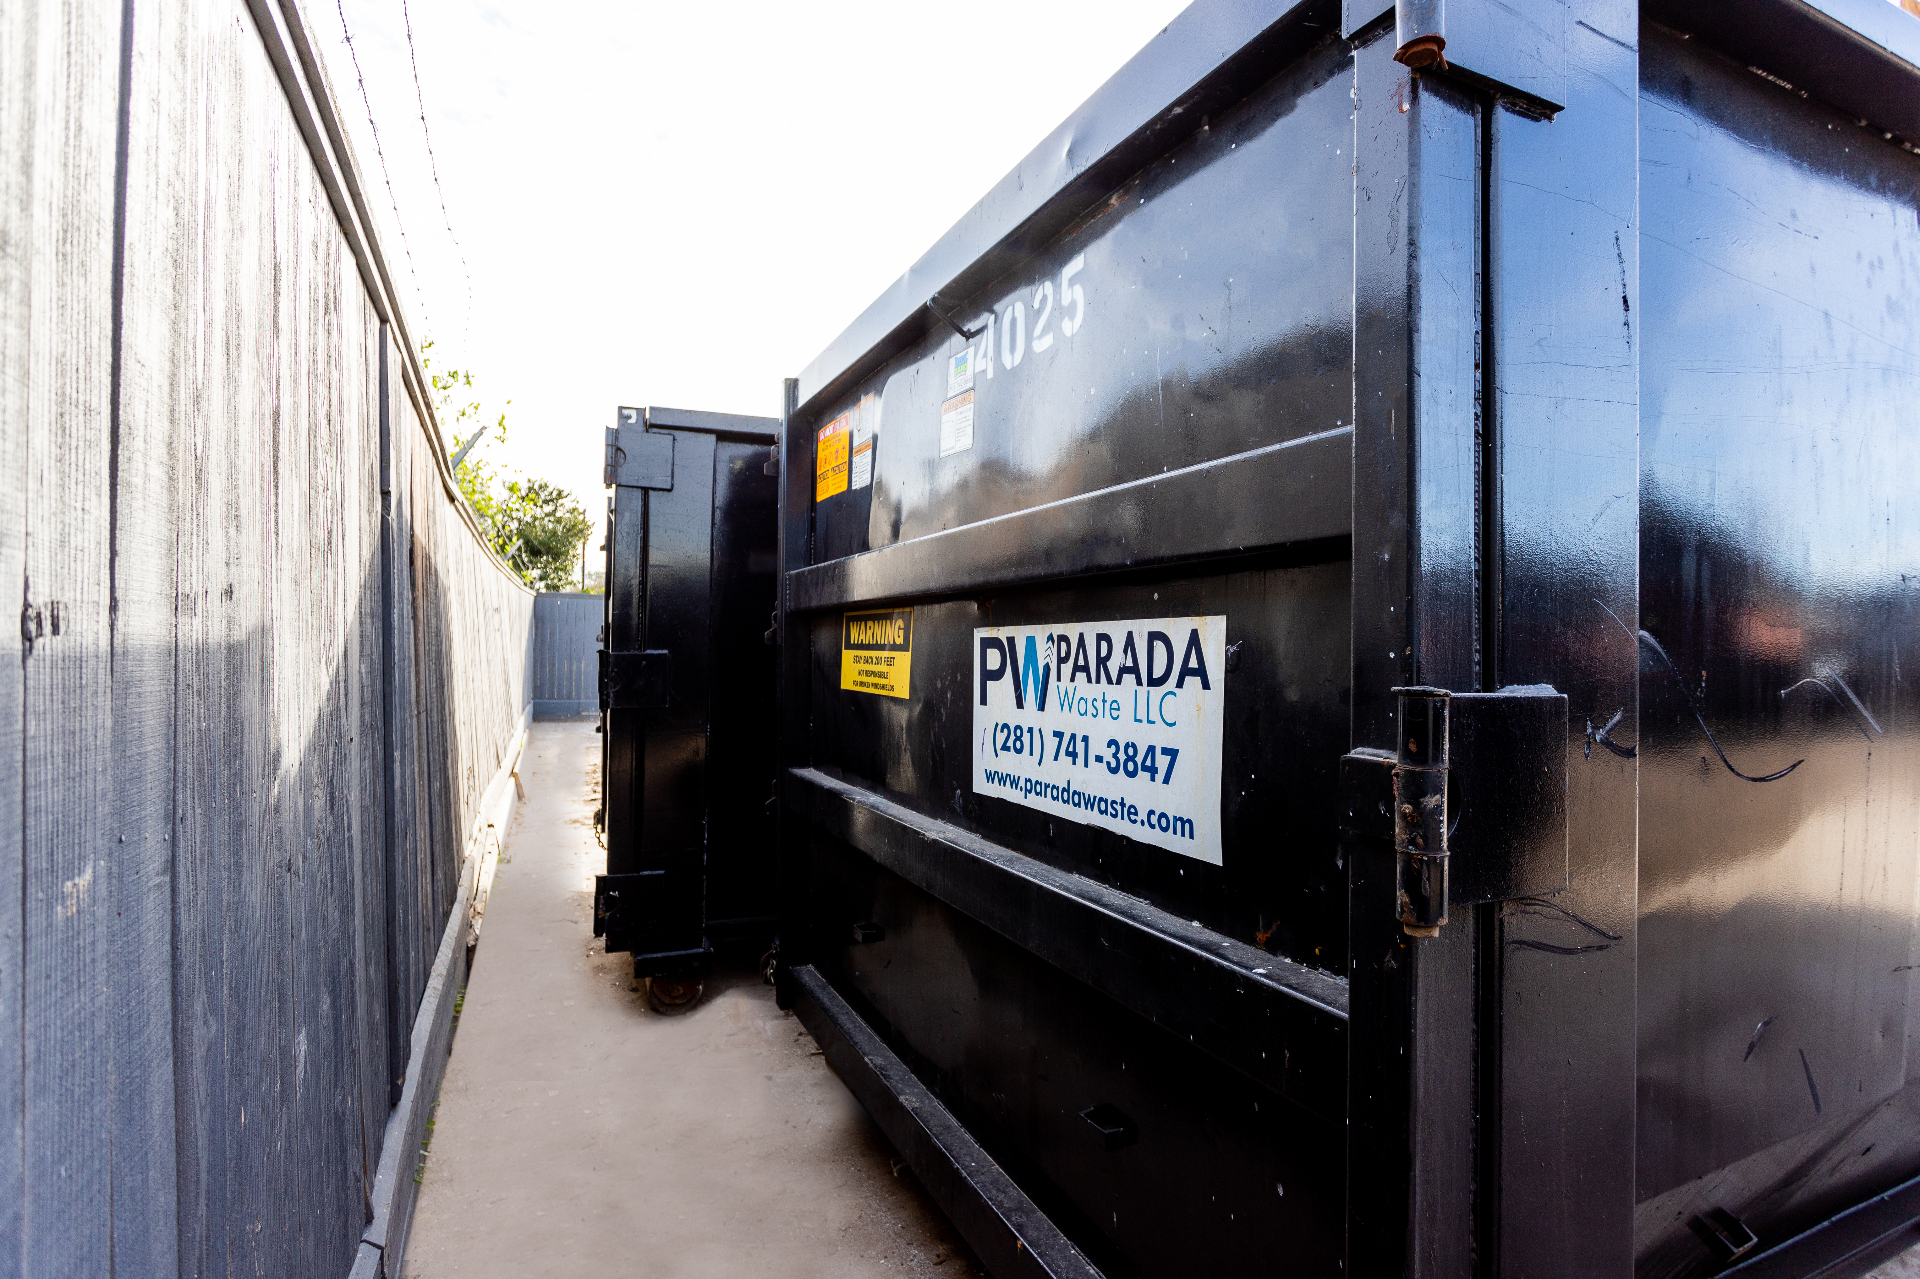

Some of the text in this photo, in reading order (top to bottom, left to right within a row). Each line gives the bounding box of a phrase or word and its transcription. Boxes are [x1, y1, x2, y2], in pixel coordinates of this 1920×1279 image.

[974, 253, 1085, 379] 4025
[849, 619, 905, 645] WARNING
[853, 655, 862, 665] STAY
[863, 655, 874, 666] BACK
[883, 657, 895, 667] FEET
[1056, 628, 1211, 691] PARADA
[865, 669, 889, 680] RESPONSIBLE
[979, 632, 1055, 712] PW
[1057, 684, 1177, 728] Waste LLC
[992, 721, 1180, 785] (281) 741-3847
[984, 768, 1195, 841] www.paradawaste.com
